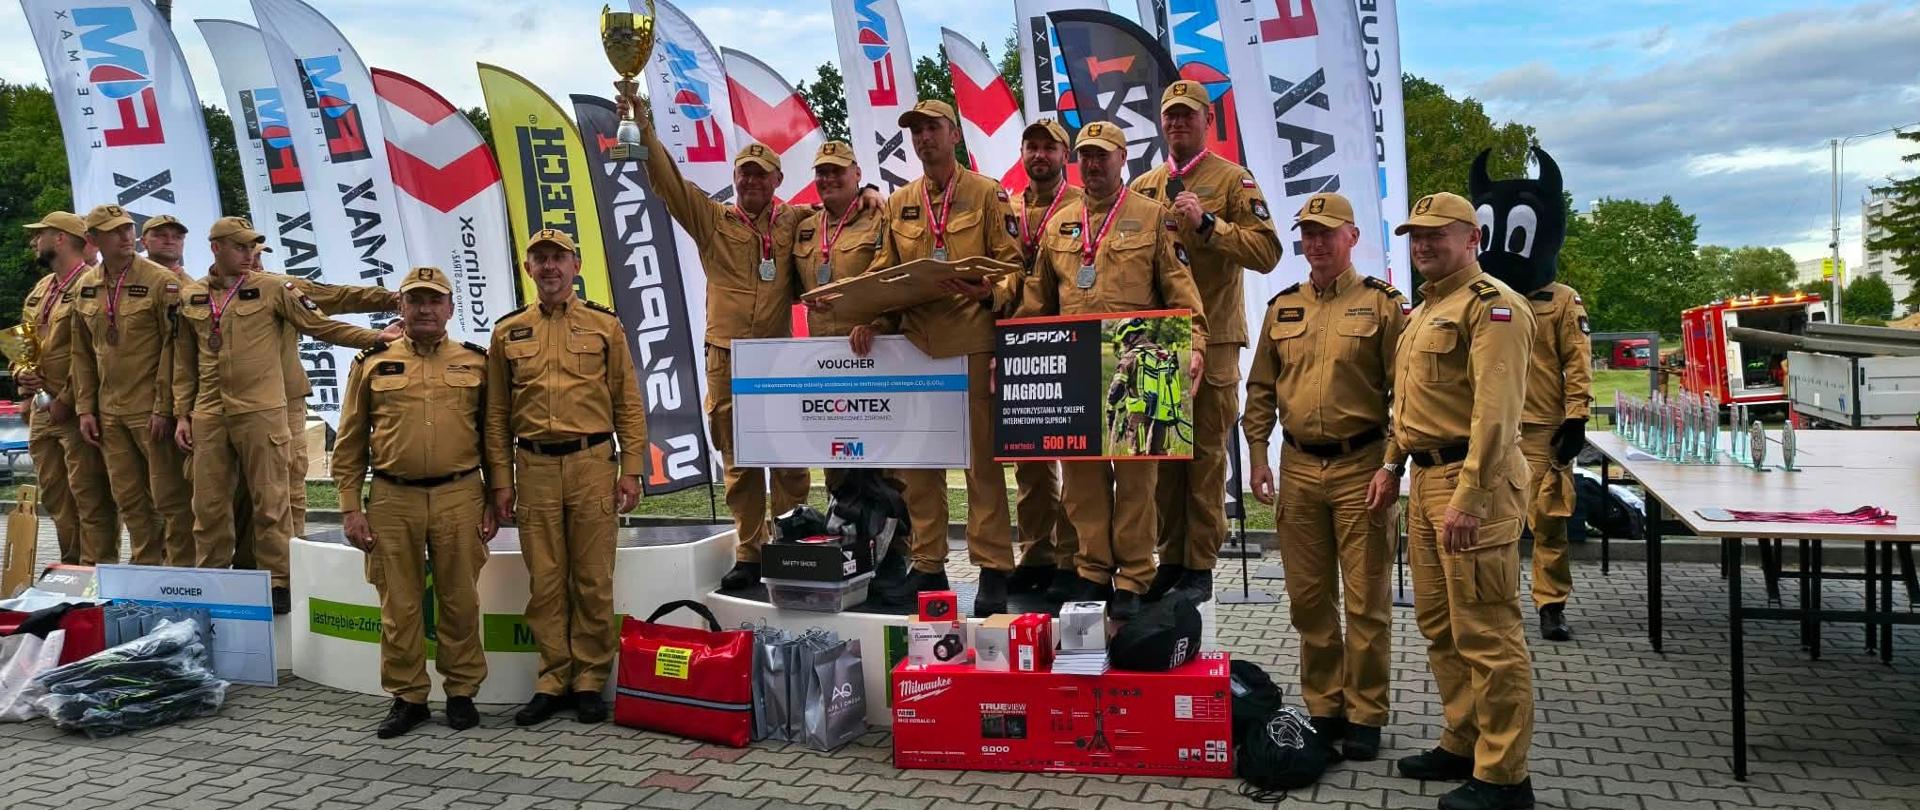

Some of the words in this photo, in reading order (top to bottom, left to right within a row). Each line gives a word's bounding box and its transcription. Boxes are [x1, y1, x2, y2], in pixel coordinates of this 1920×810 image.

[817, 358, 875, 369] VOUCHER
[1003, 355, 1067, 376] VOUCHER
[1003, 382, 1062, 401] NAGRODA
[802, 398, 890, 413] DECONTEX
[1063, 405, 1086, 414] SKLEPIE
[1043, 435, 1065, 450] 500
[1066, 435, 1087, 450] PLN
[160, 586, 202, 597] VOUCHER
[313, 609, 382, 632] Jastrzębie-Zdró
[898, 677, 952, 696] Milwaukee
[981, 745, 1010, 753] 6000
